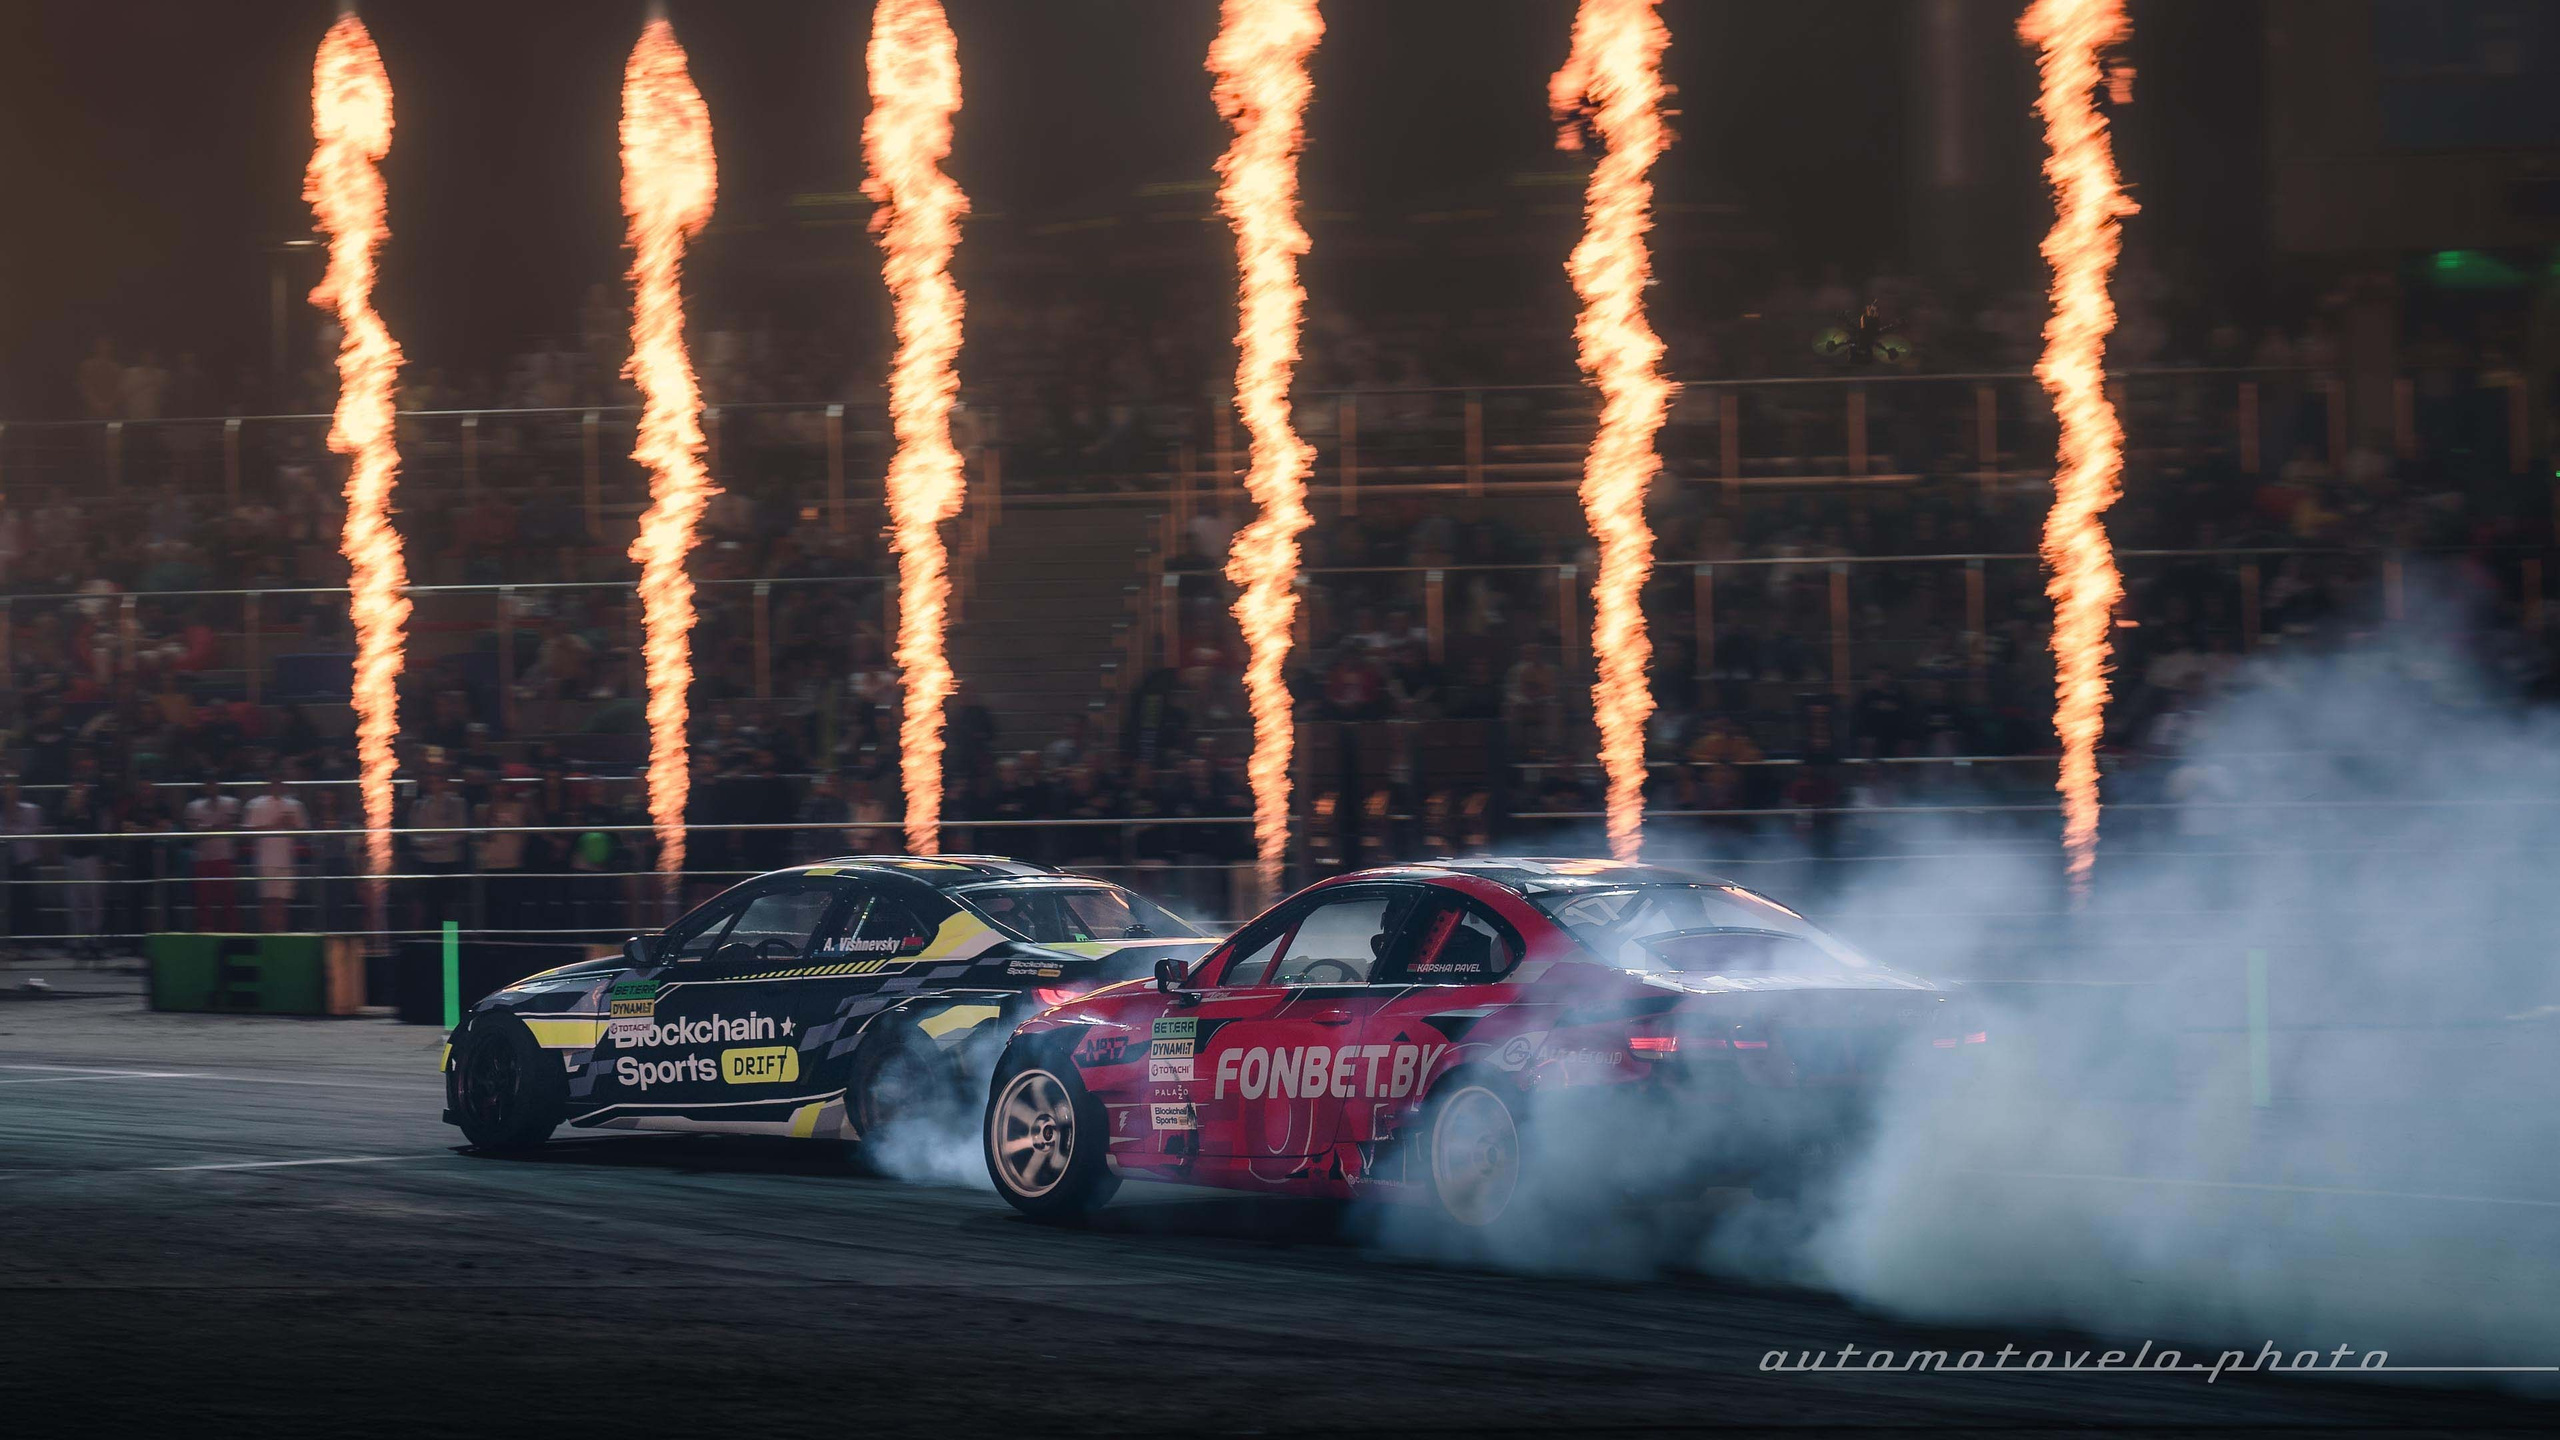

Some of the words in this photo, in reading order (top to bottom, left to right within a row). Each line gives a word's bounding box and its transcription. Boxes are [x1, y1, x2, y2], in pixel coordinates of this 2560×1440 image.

[823, 937, 835, 951] A.
[839, 937, 900, 953] Vishnevsky
[1417, 963, 1453, 973] KAPSHAI
[1454, 963, 1481, 973] PAVEL
[616, 1053, 718, 1091] Sports
[734, 1054, 788, 1076] DRIFT
[1159, 1065, 1189, 1074] TOTACHI
[1214, 1043, 1447, 1100] FONBET.BY
[1155, 1116, 1178, 1126] Sports
